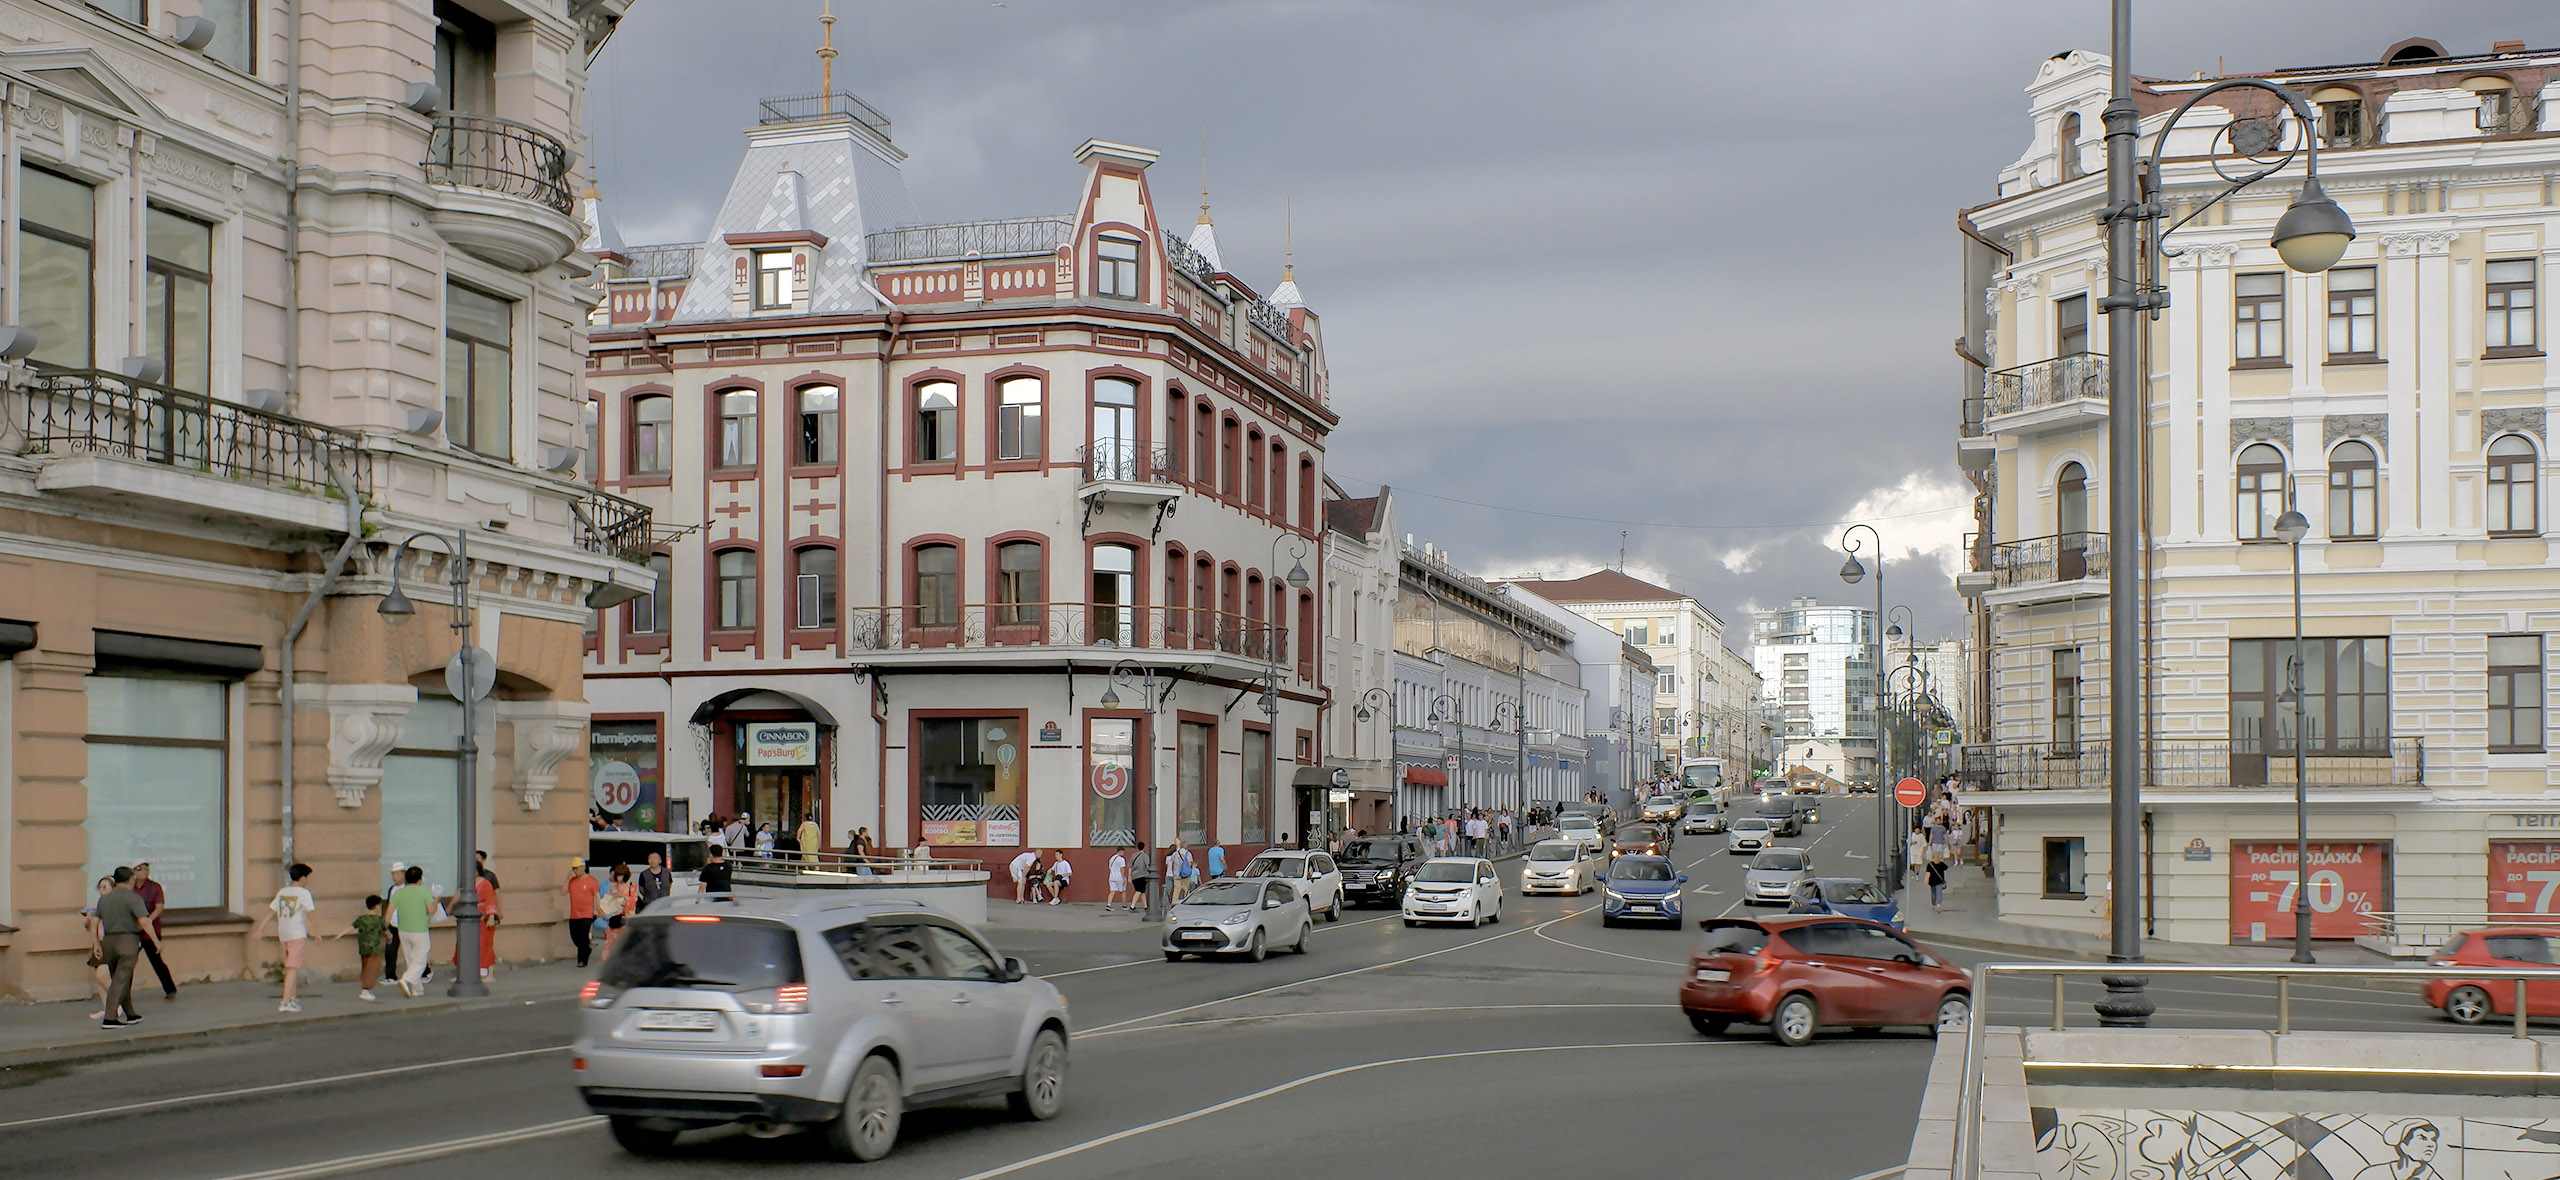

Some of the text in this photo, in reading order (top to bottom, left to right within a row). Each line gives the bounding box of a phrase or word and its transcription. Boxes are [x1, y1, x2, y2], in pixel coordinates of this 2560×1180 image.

[760, 732, 806, 741] CINNABON
[1101, 763, 1119, 791] 5
[602, 782, 632, 805] 30
[2513, 814, 2560, 827] Terr
[2192, 839, 2203, 848] 13
[2251, 872, 2266, 882] до
[2506, 873, 2523, 882] до
